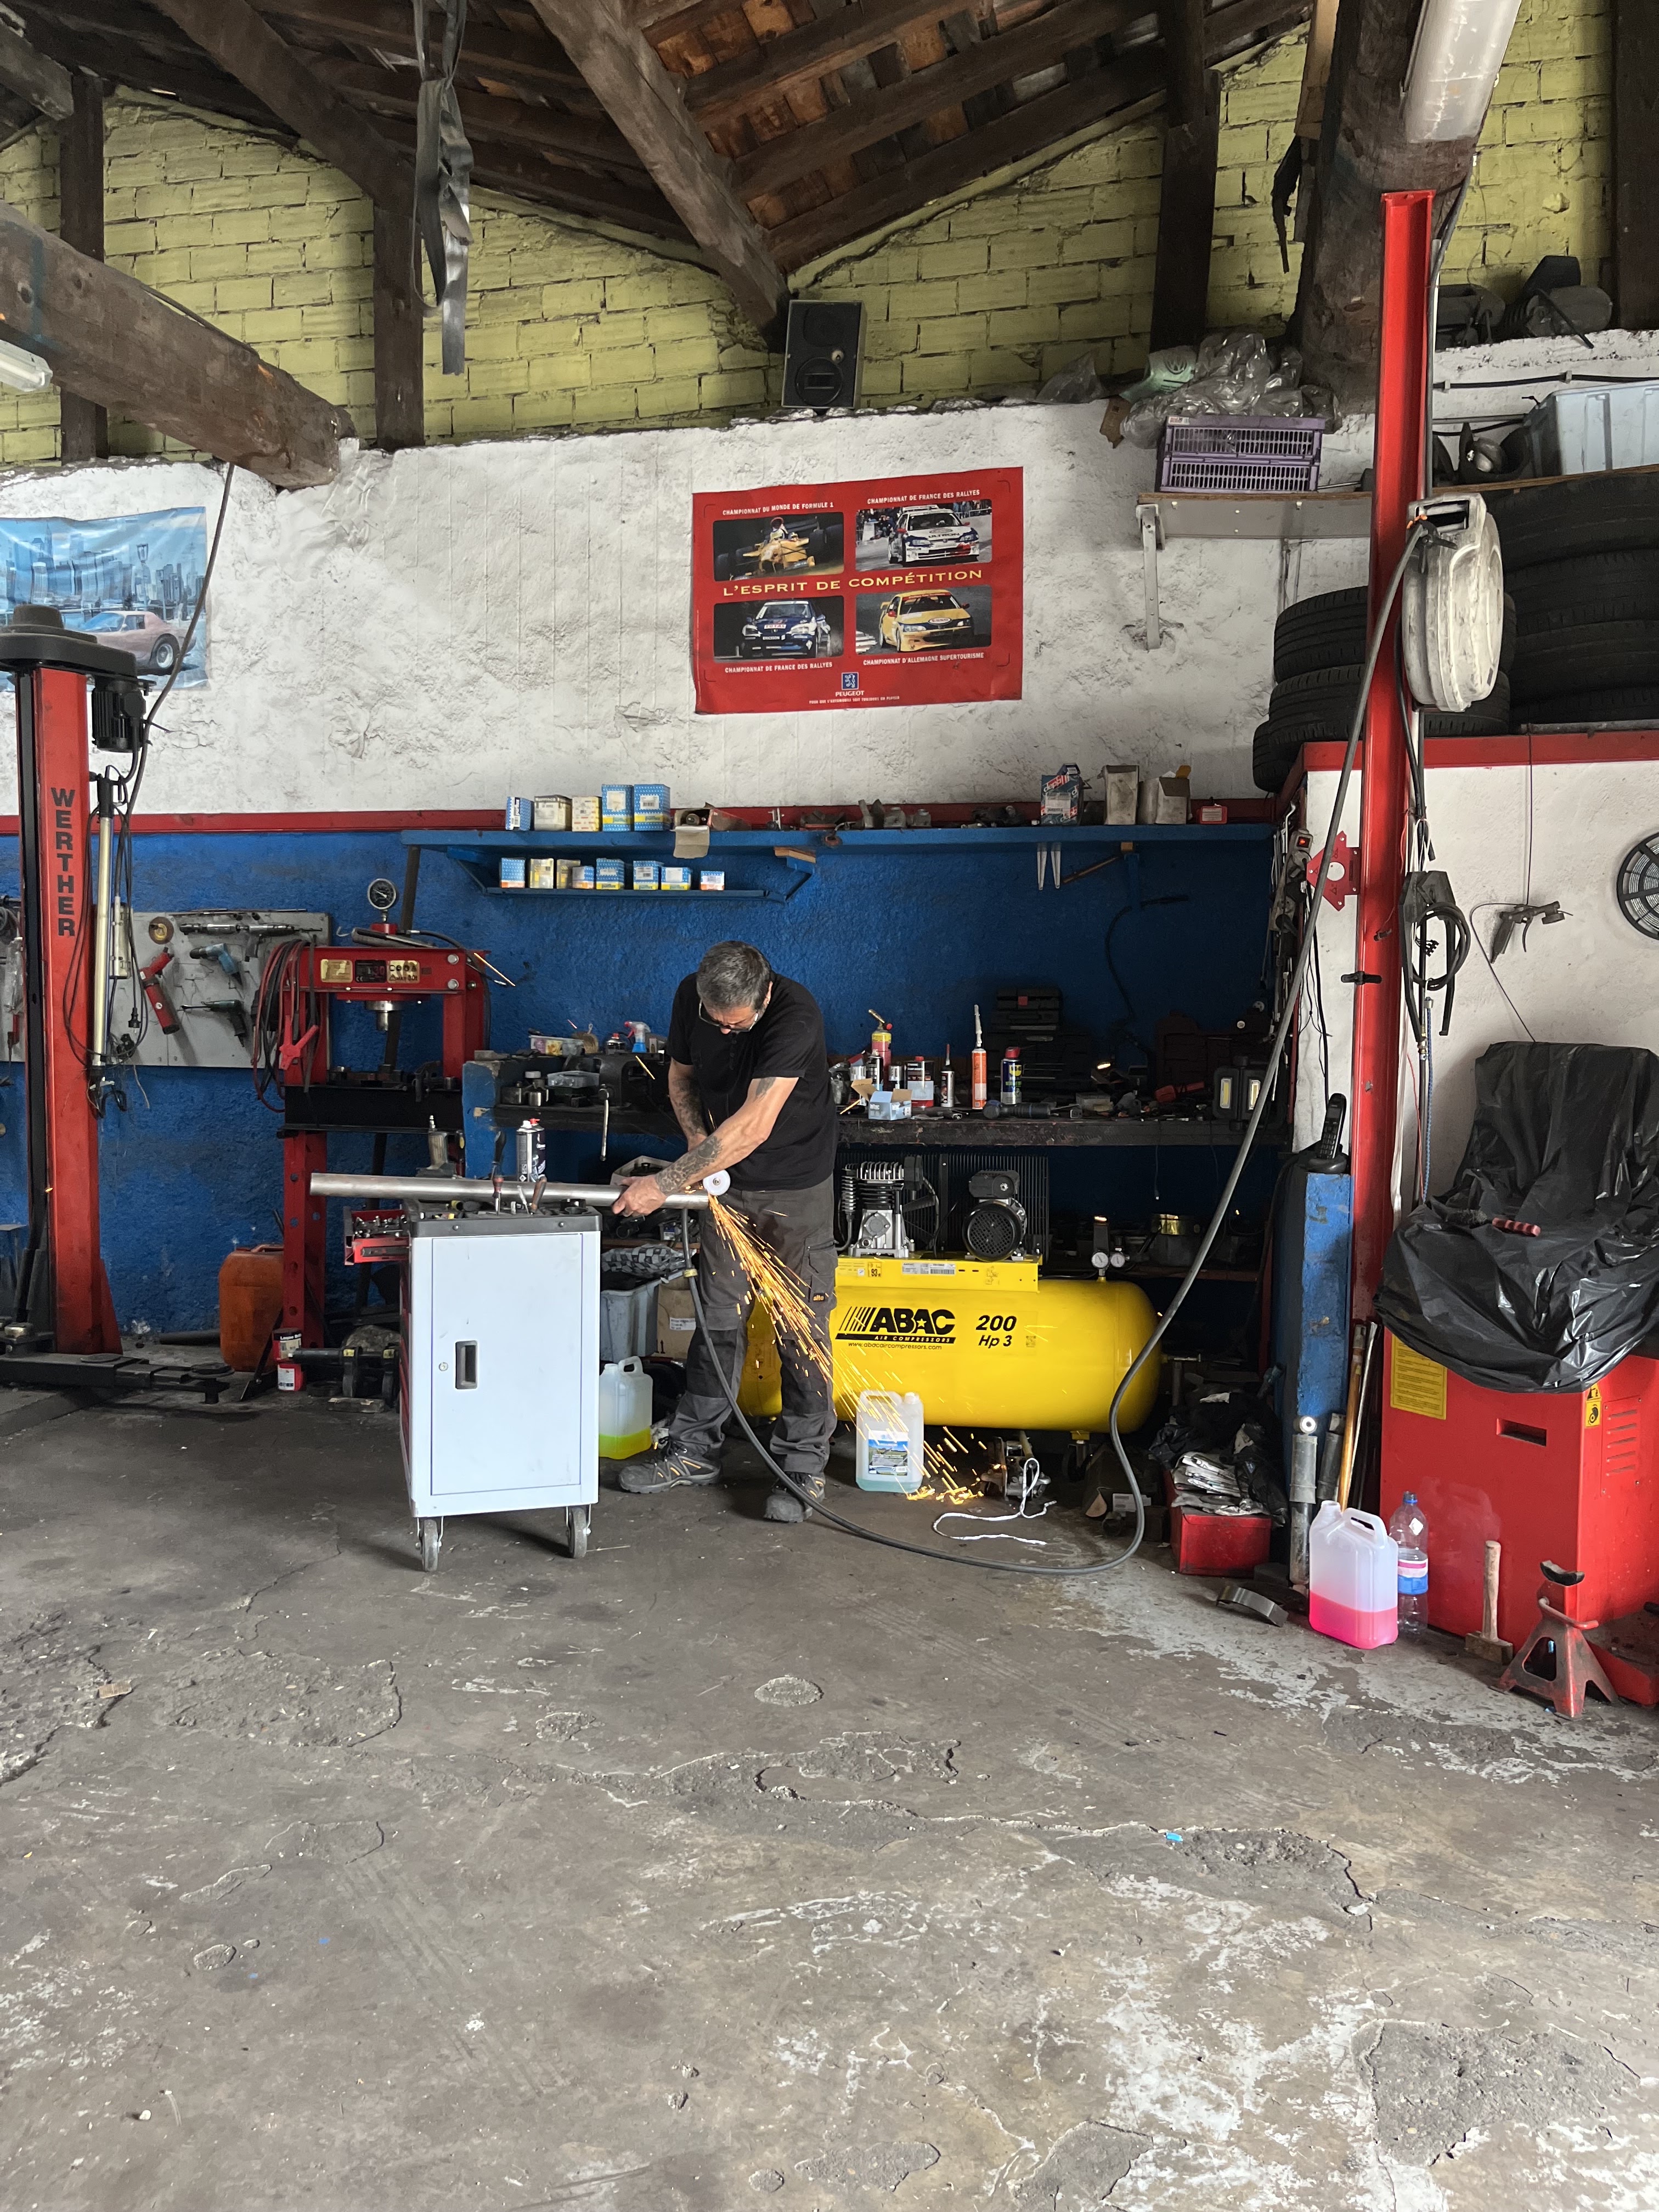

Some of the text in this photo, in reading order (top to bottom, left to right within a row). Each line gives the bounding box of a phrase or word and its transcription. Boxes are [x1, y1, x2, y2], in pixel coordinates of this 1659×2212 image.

[867, 496, 907, 504] CHAMPIONNAT
[724, 570, 982, 596] L'ESPRIT DE COMPÉTITION
[940, 652, 984, 661] SUPERTOURISME
[50, 787, 75, 936] WERTHER
[870, 1307, 955, 1335] ABAC
[976, 1314, 1017, 1331] 200
[848, 1342, 942, 1350] www.abacaircompressors.com
[978, 1335, 1012, 1348] Hp 3
